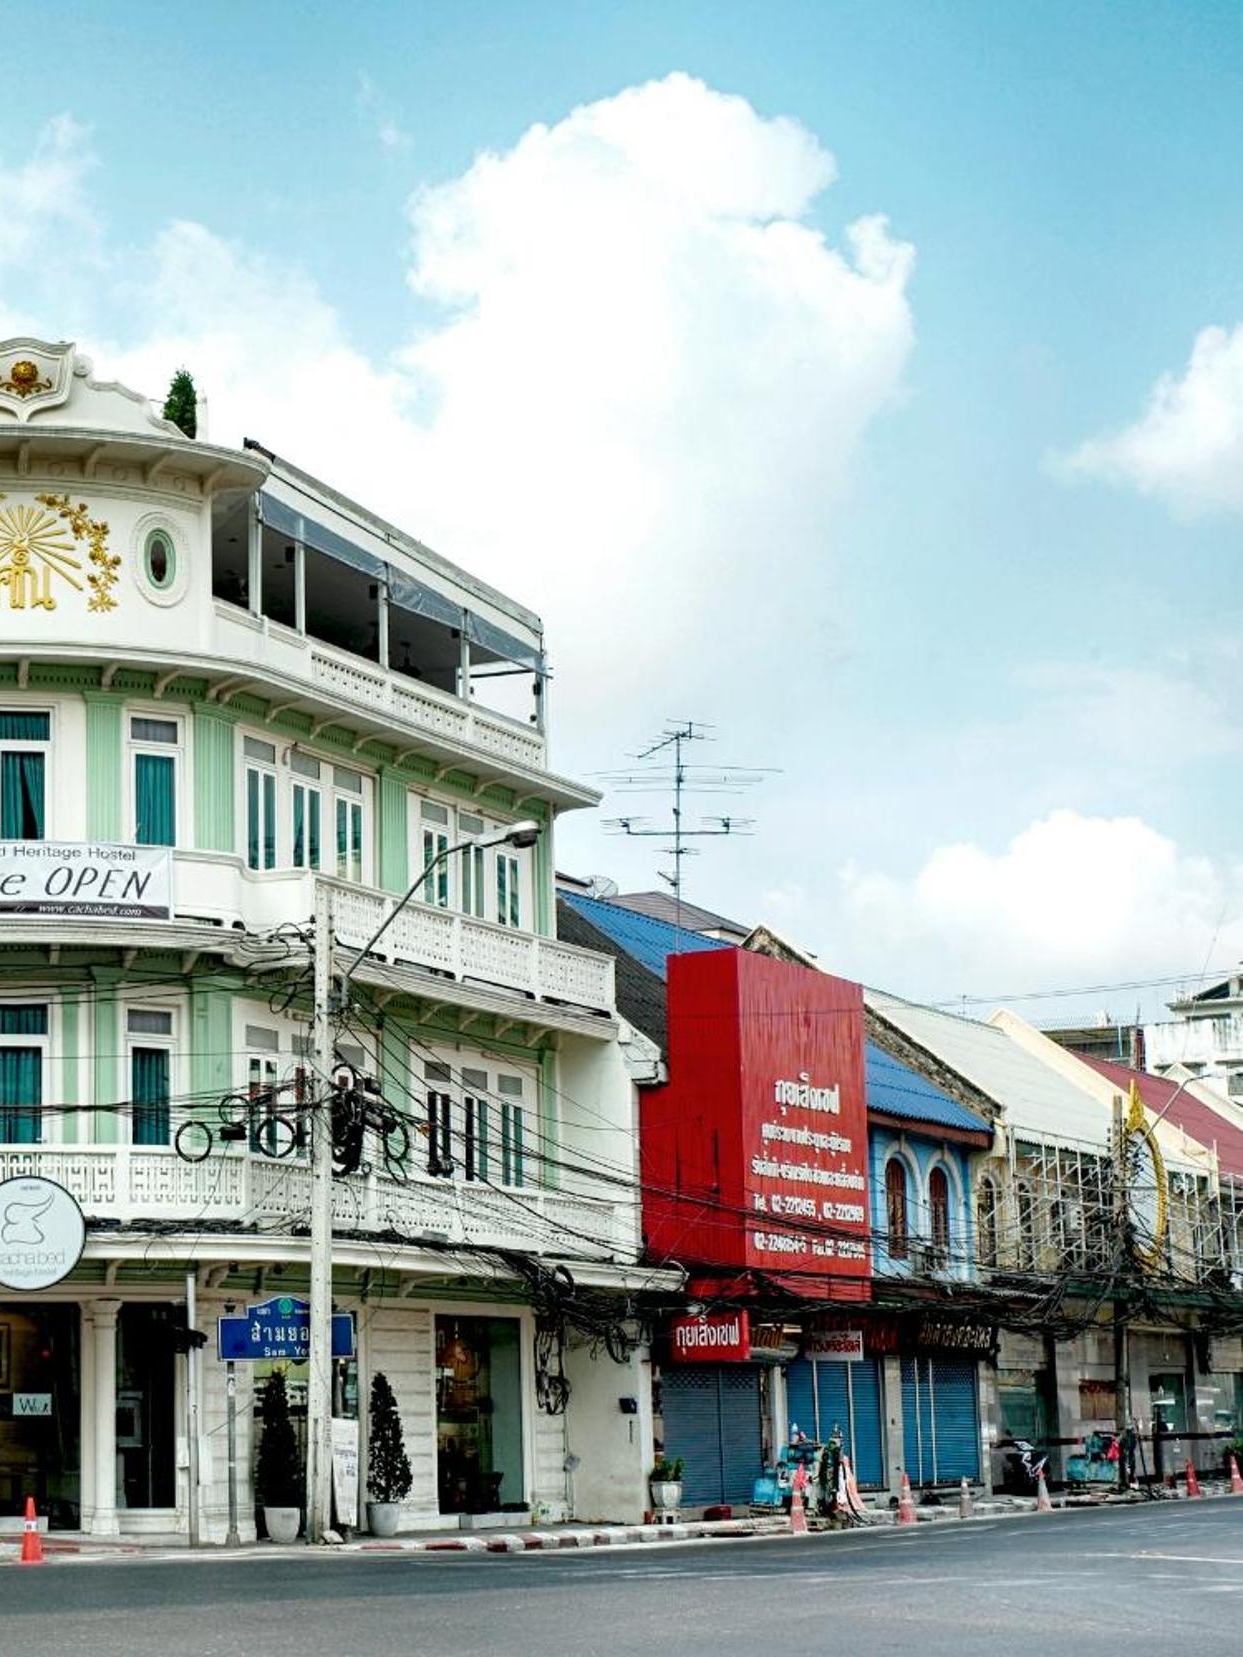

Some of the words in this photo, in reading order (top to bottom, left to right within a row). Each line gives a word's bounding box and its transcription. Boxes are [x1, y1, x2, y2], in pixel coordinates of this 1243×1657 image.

[13, 845, 82, 861] Heritage
[89, 847, 136, 861] Hostel
[45, 866, 152, 899] OPEN
[252, 1321, 309, 1342] สามยอ
[264, 1346, 286, 1357] Sam
[294, 1346, 310, 1357] Yo
